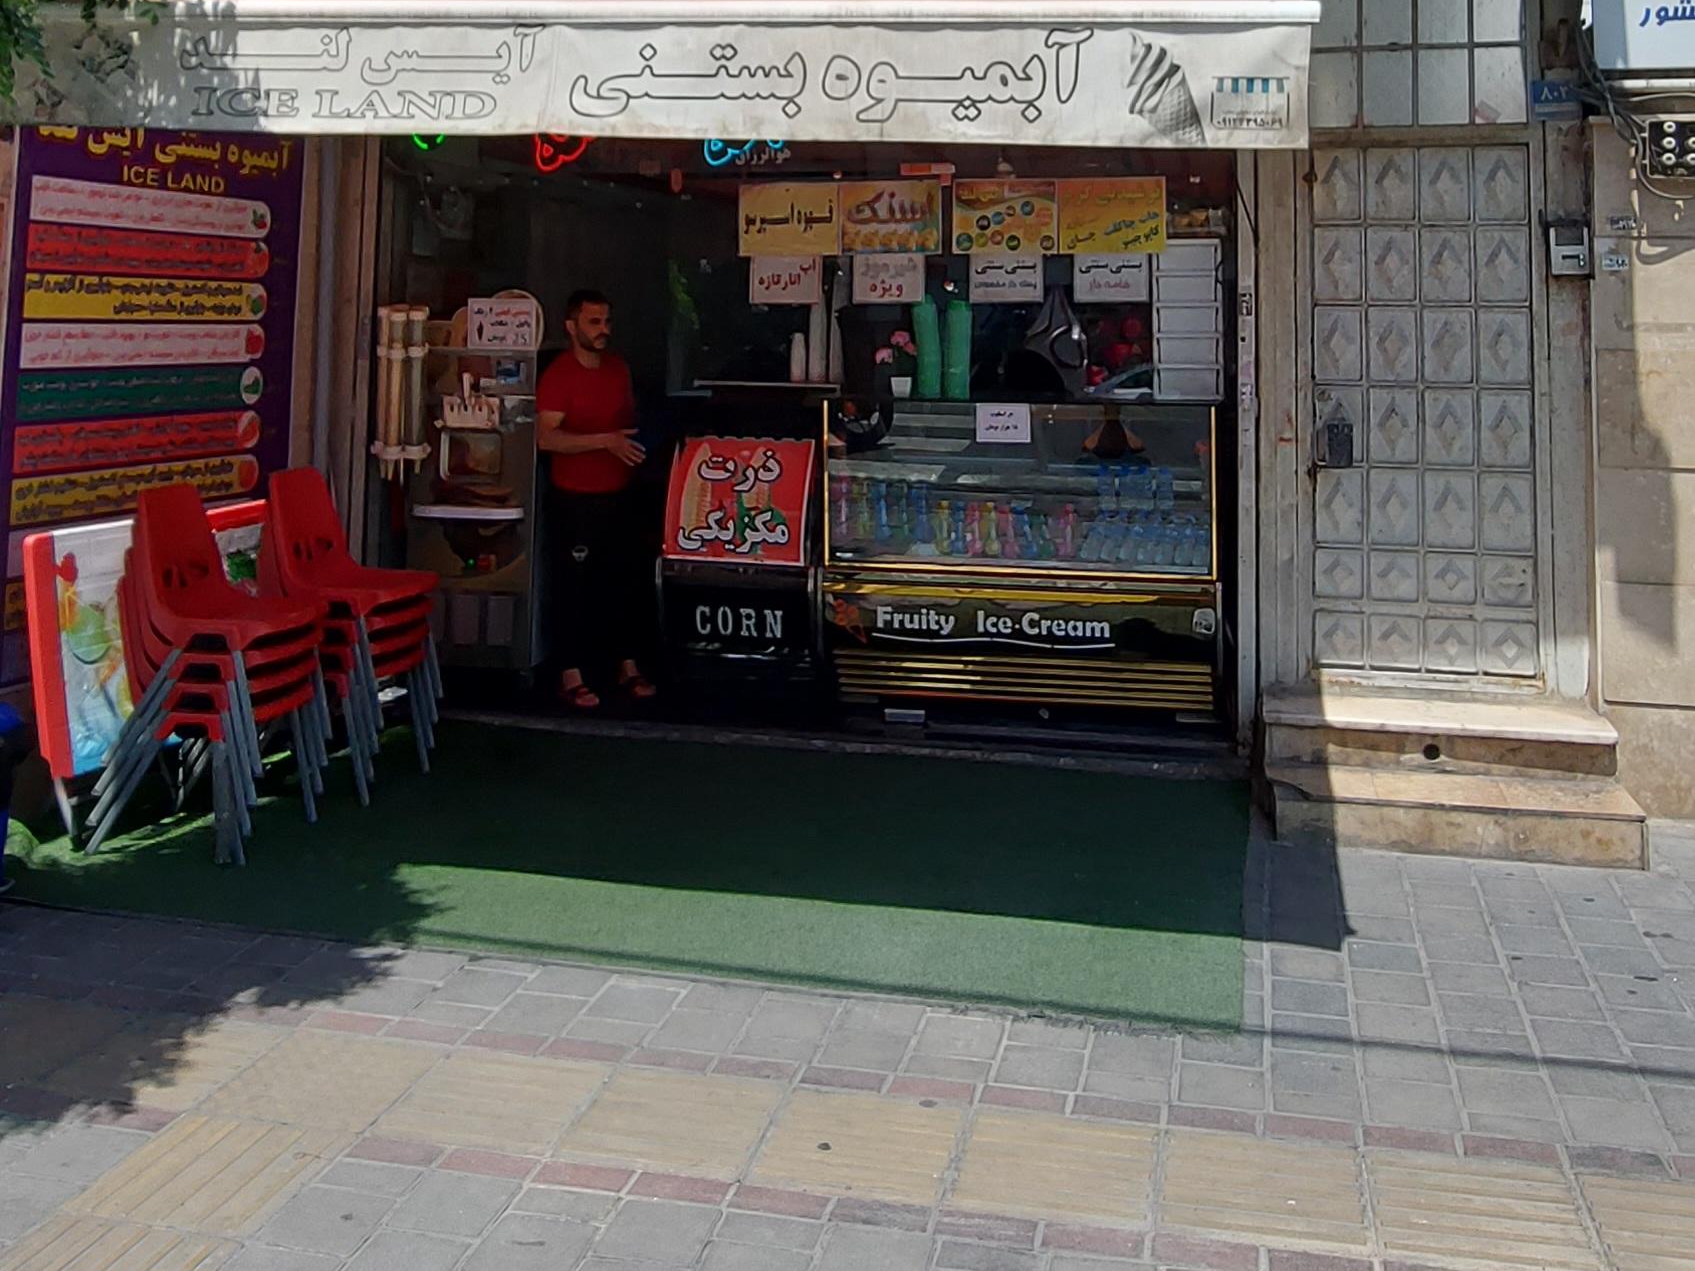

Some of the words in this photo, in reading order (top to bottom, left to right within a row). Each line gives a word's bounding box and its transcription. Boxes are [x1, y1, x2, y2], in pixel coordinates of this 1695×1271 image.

[571, 42, 806, 119] بستنی
[822, 27, 1093, 123] آبمیوه
[192, 86, 300, 119] ICE
[312, 88, 497, 120] LAND
[154, 131, 221, 169] بستنی
[227, 140, 291, 176] آبمیوه
[122, 164, 159, 186] ICE
[167, 171, 225, 193] LAND
[698, 448, 782, 491] ذرت
[677, 506, 791, 553] مکزیکی
[694, 604, 784, 640] CORN
[875, 606, 956, 637] Fruity
